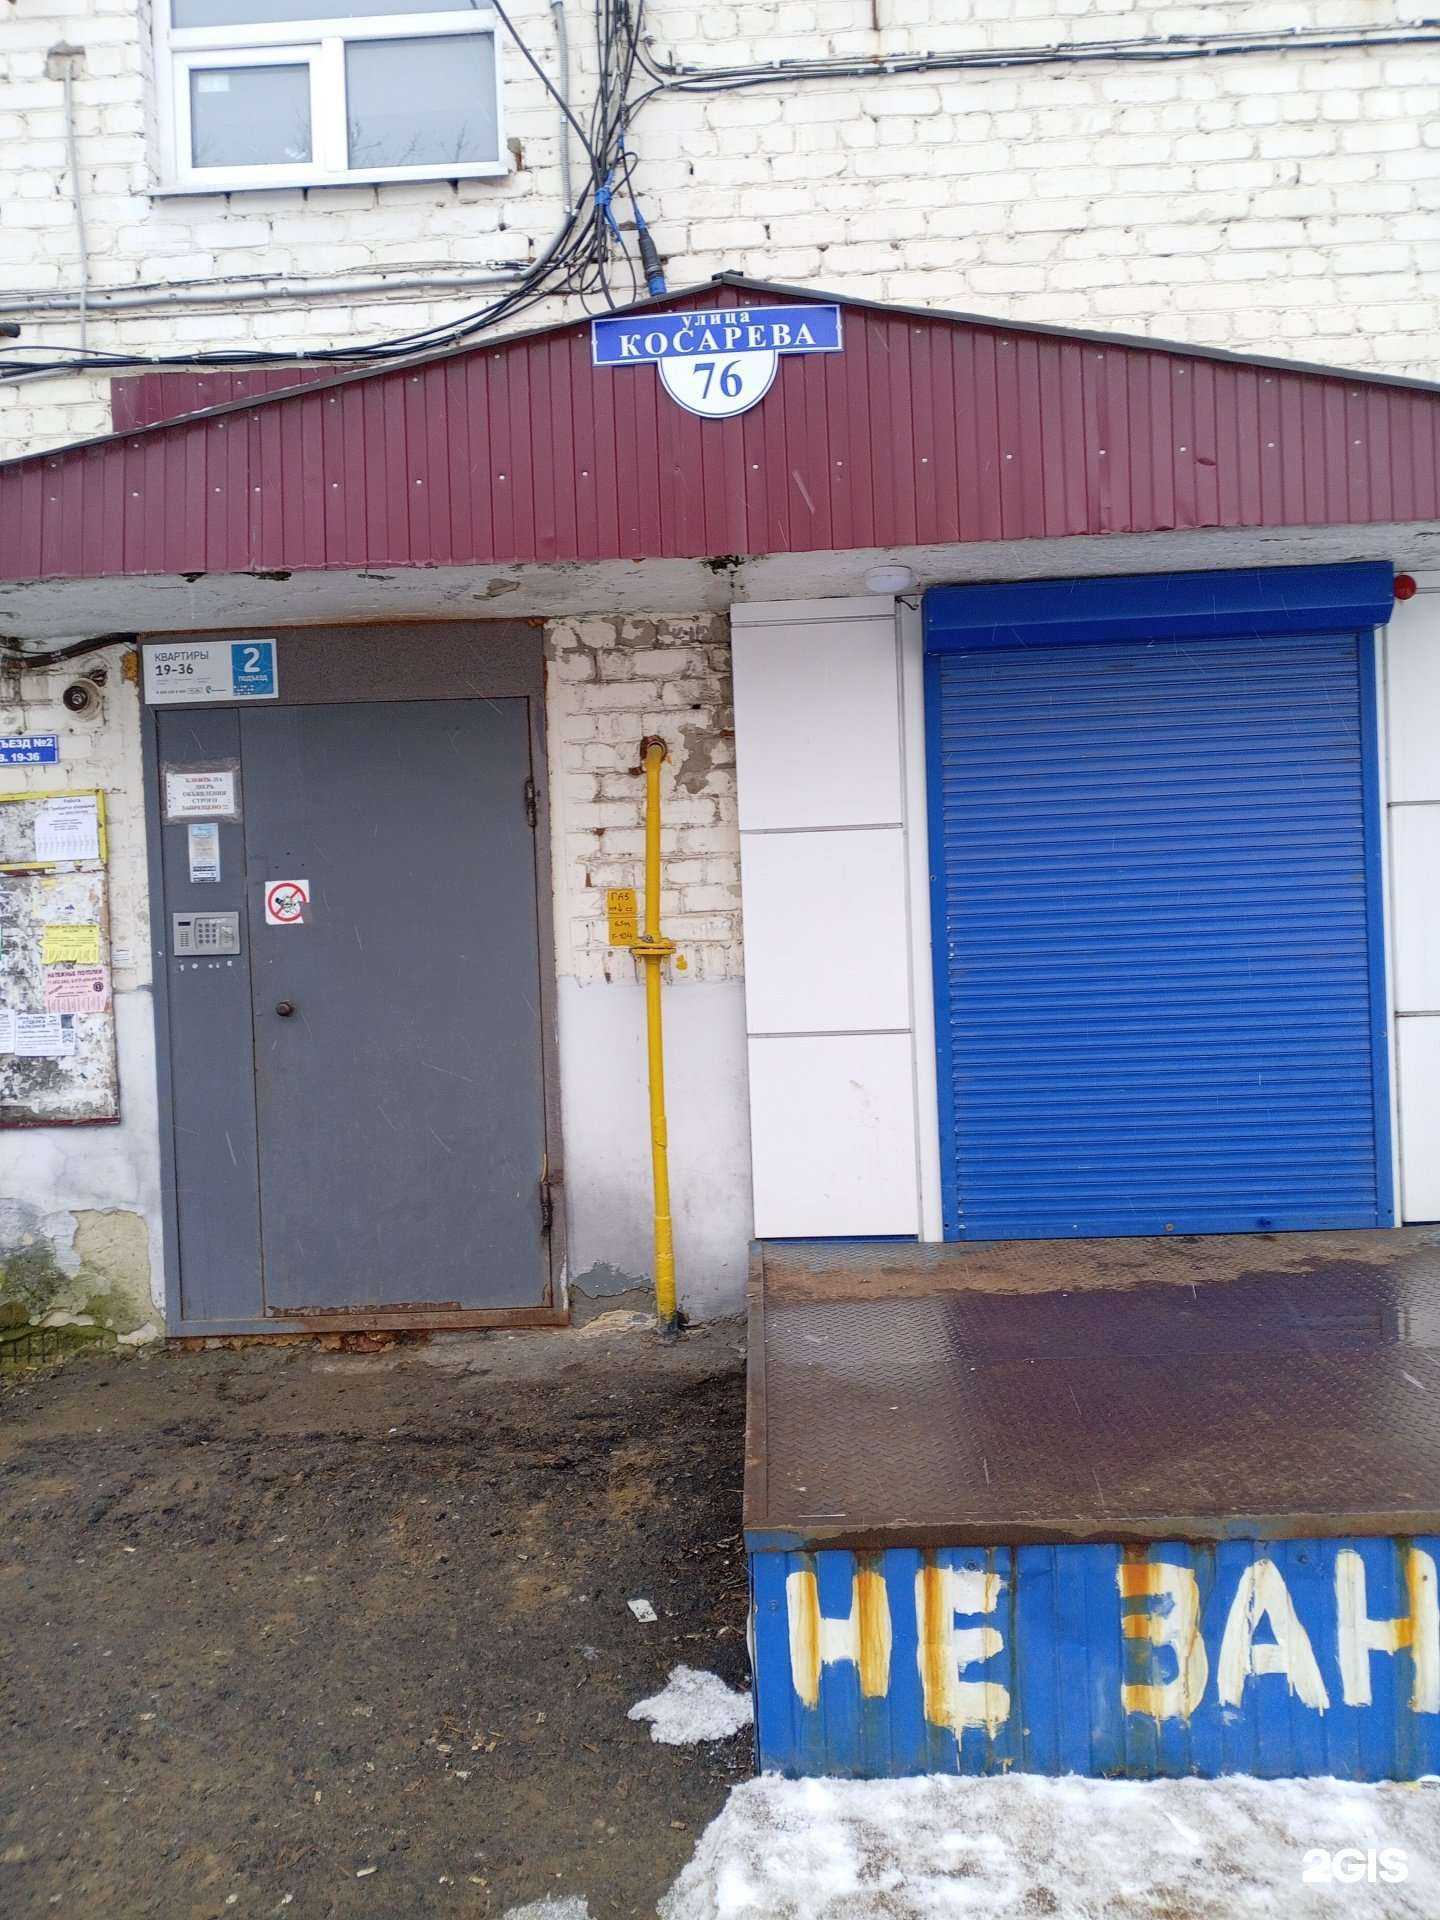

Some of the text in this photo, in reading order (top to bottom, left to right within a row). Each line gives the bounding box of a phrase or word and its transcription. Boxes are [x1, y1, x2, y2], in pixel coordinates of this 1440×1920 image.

[681, 311, 751, 331] улица
[618, 323, 816, 357] КОСАРЕВА
[692, 359, 743, 400] 76
[154, 650, 209, 662] КВАРТИРЫ
[243, 647, 261, 673] 2
[155, 663, 194, 676] 19-36
[33, 738, 54, 747] №2
[11, 752, 40, 762] 19-36
[786, 1565, 1010, 1730] НЕ
